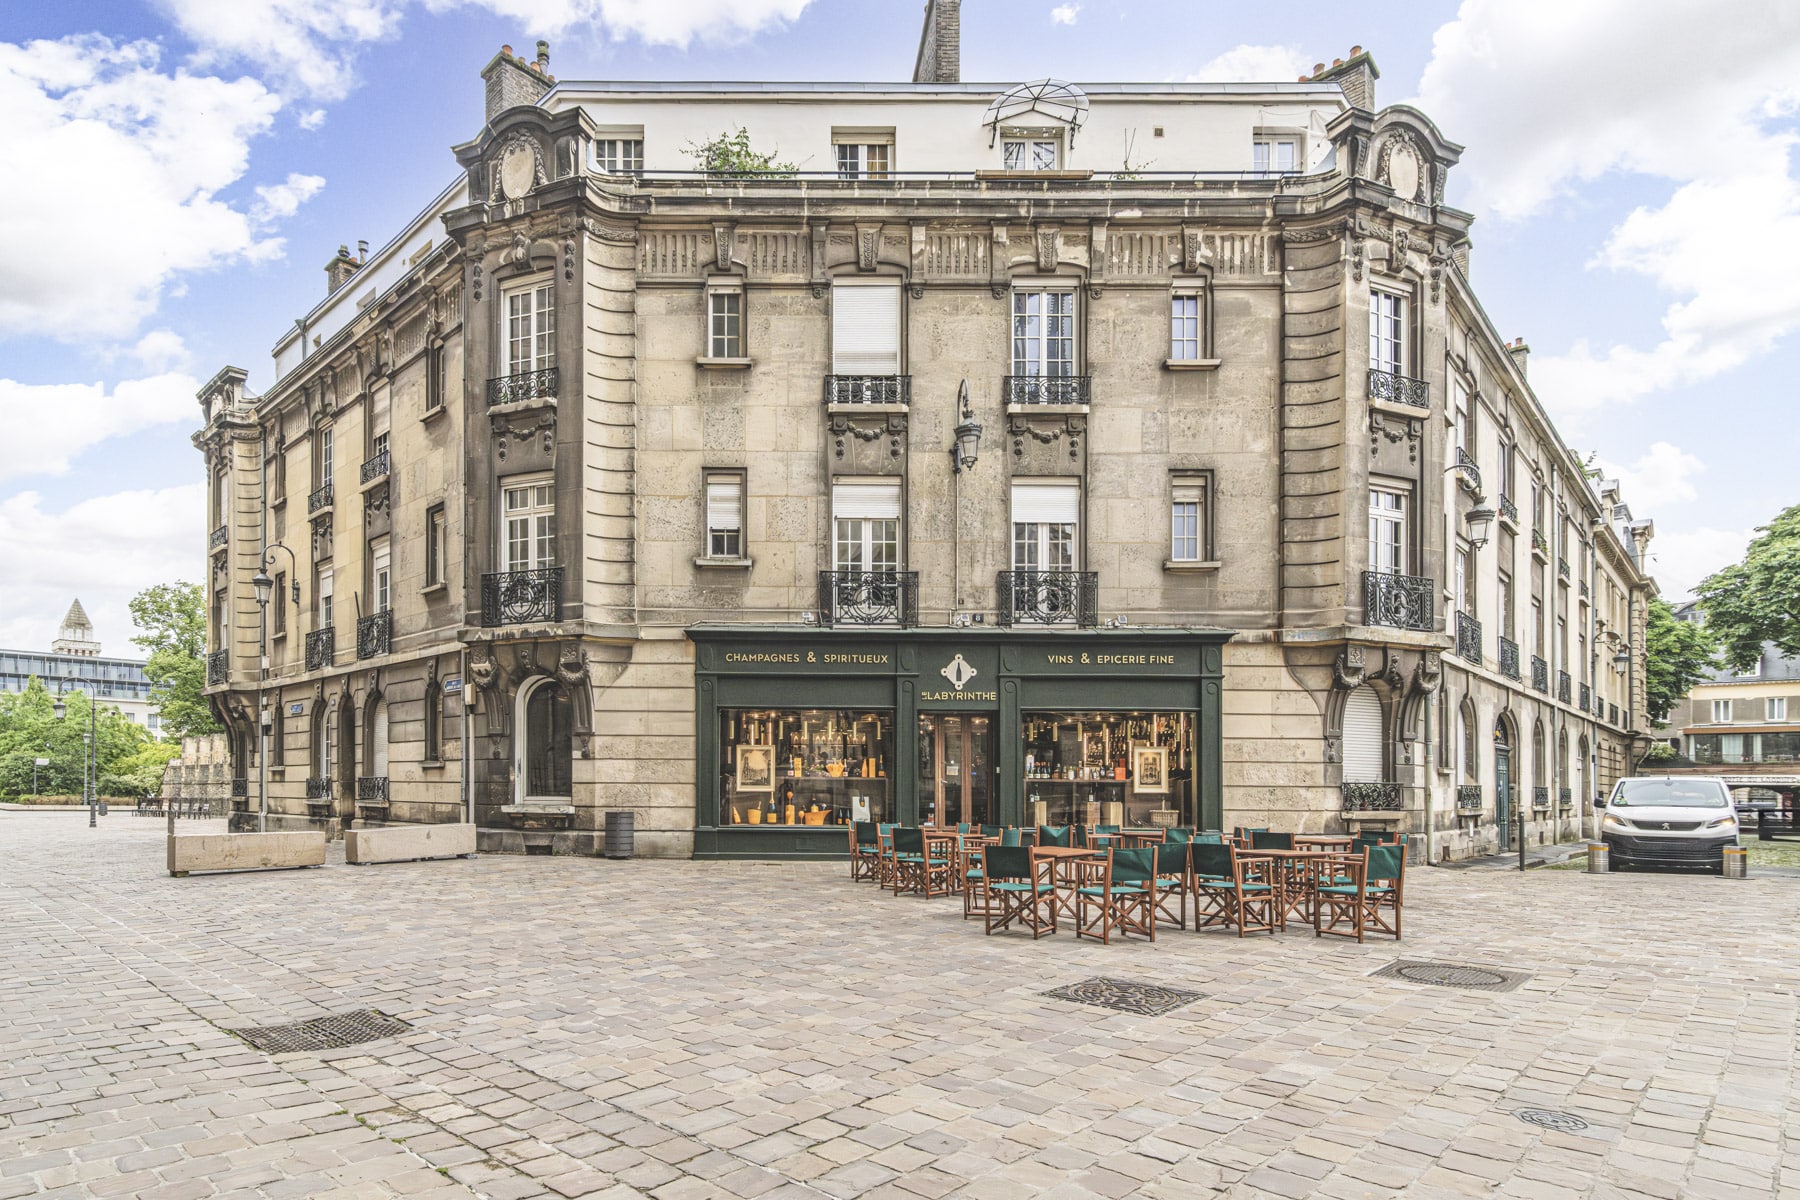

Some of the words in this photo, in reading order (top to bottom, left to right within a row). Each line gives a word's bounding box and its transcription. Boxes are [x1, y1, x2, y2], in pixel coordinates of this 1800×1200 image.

[725, 653, 800, 663] CHAMPAGNES
[806, 651, 816, 663] &
[823, 654, 888, 664] SPIRITUEUX
[1047, 655, 1074, 664] VINS
[1080, 652, 1091, 664] &
[1097, 655, 1146, 664] EPICERIE
[1149, 655, 1175, 664] FINE
[921, 691, 927, 700] LE
[927, 691, 997, 701] LABYRINTHE
